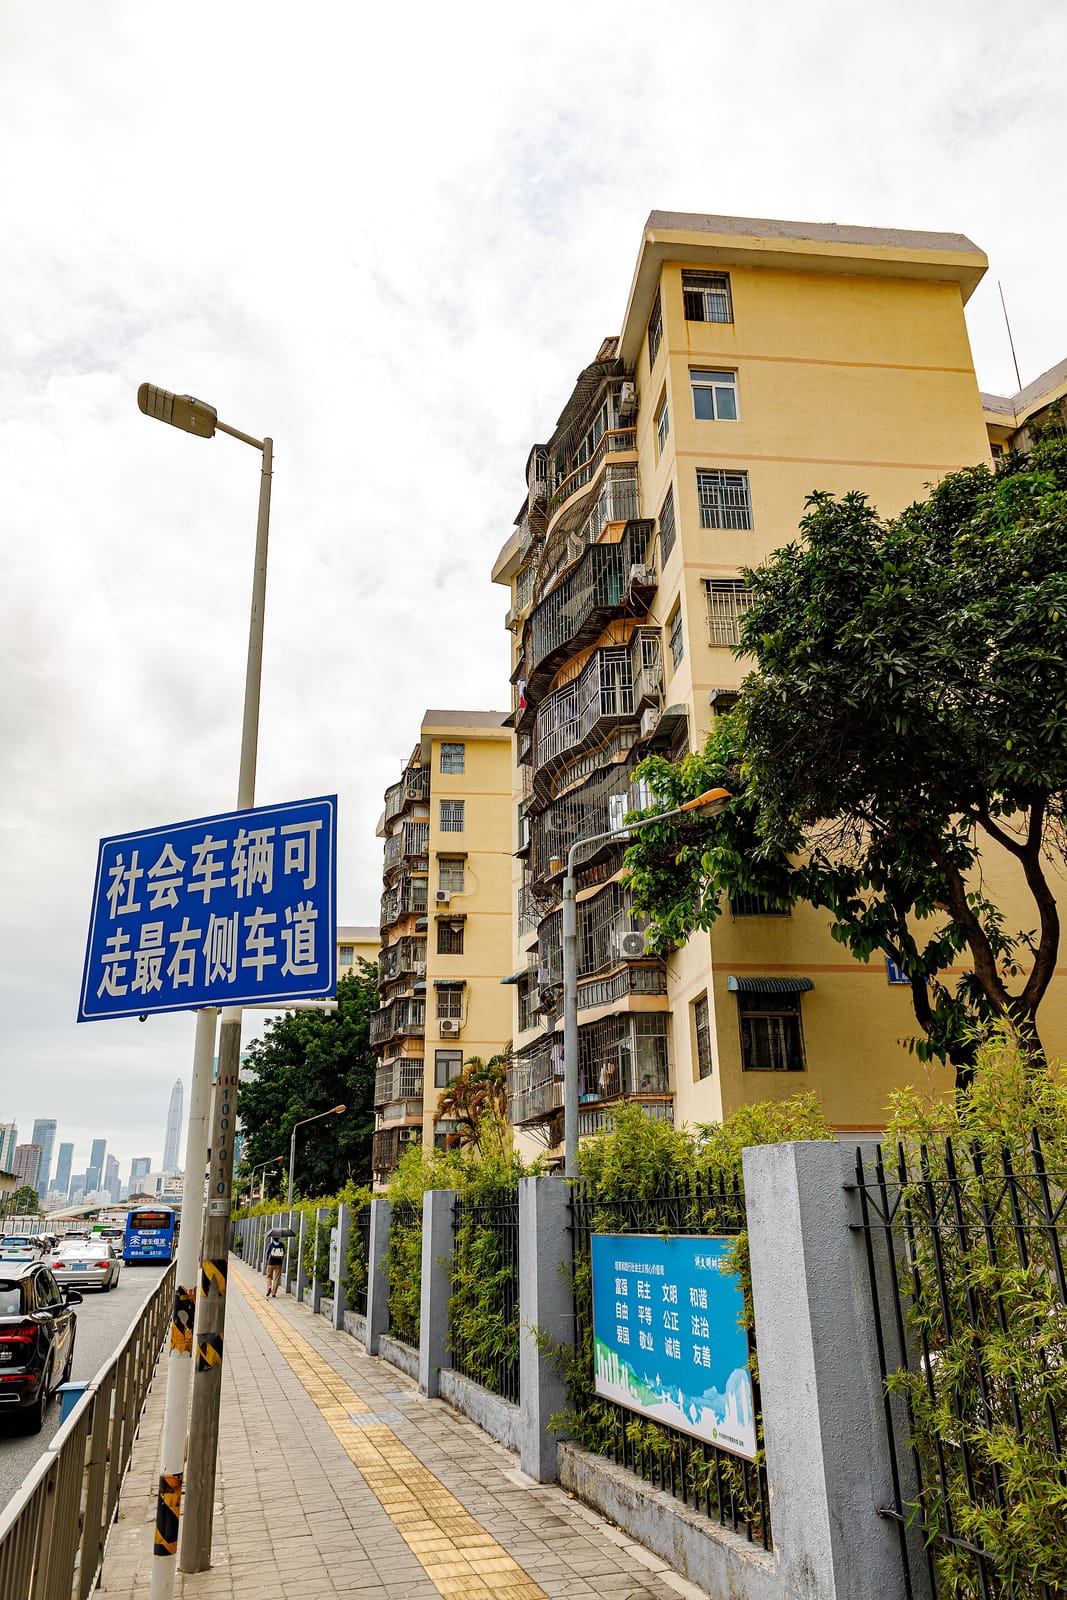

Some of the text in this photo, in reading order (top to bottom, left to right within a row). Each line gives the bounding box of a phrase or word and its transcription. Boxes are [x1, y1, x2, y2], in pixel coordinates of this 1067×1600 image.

[106, 820, 322, 920] 社会车辆可
[97, 900, 319, 999] 走最右侧车道
[614, 1277, 708, 1310] 富强 民主 文明 和谐
[615, 1302, 710, 1339] 自由 平等 公正 法治
[616, 1325, 711, 1368] 爱国 敬业 诚信 友善
